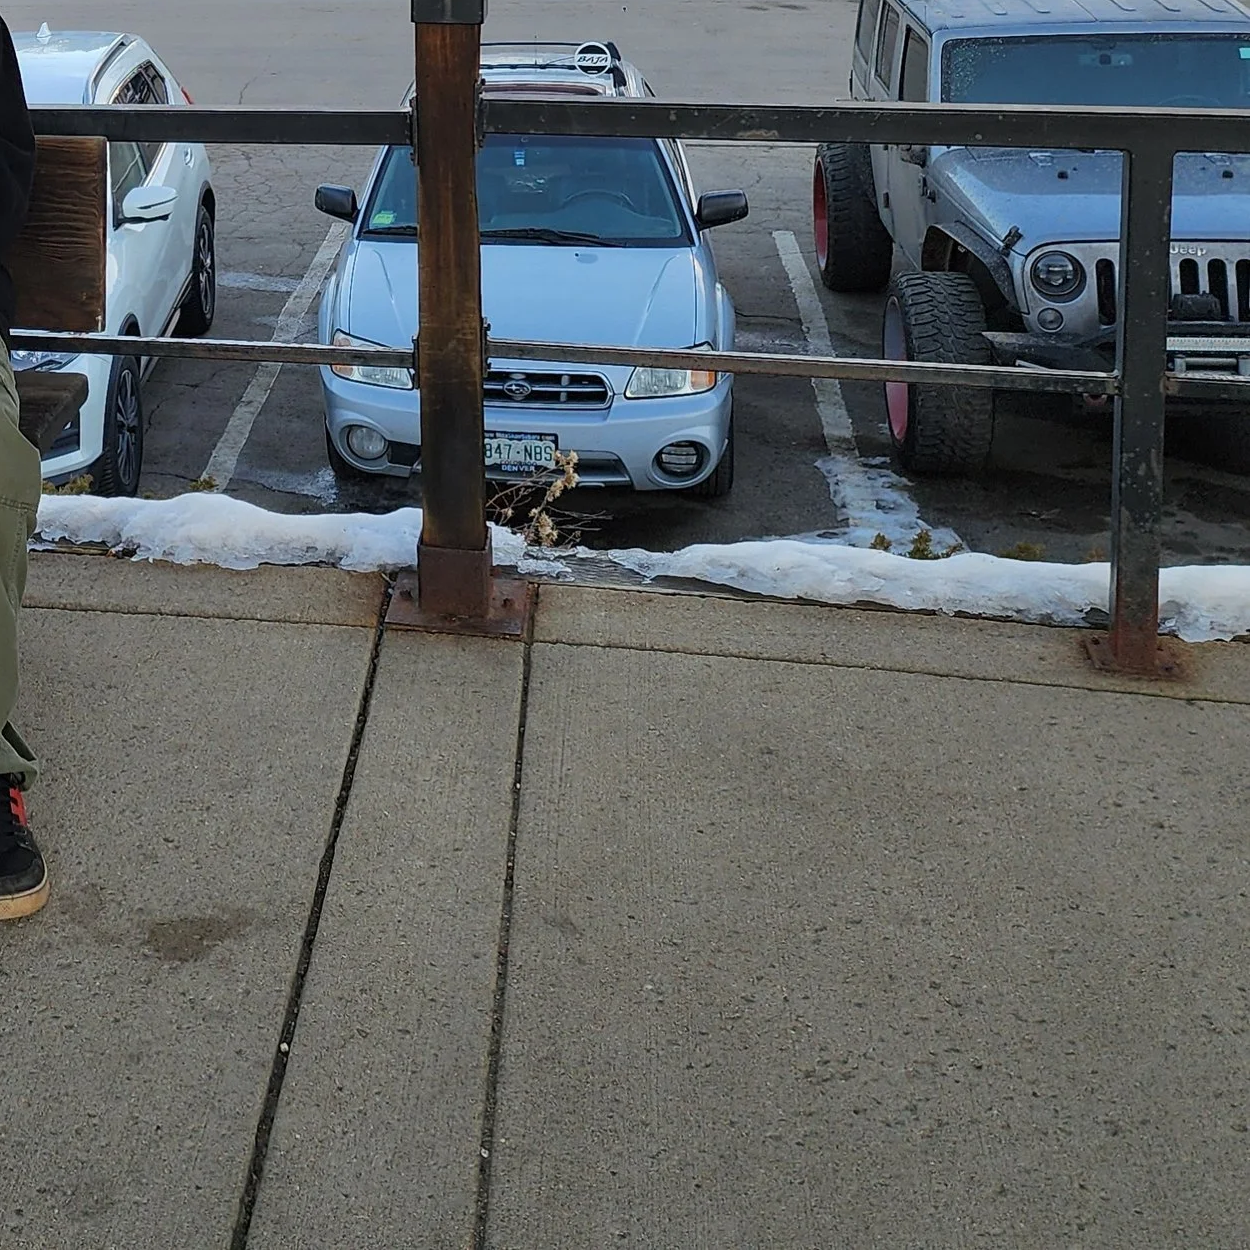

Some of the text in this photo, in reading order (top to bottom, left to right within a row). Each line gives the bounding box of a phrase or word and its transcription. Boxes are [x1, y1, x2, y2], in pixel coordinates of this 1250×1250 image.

[577, 55, 608, 64] BAJA
[1170, 243, 1206, 256] Jeep
[501, 464, 536, 472] DENVER
